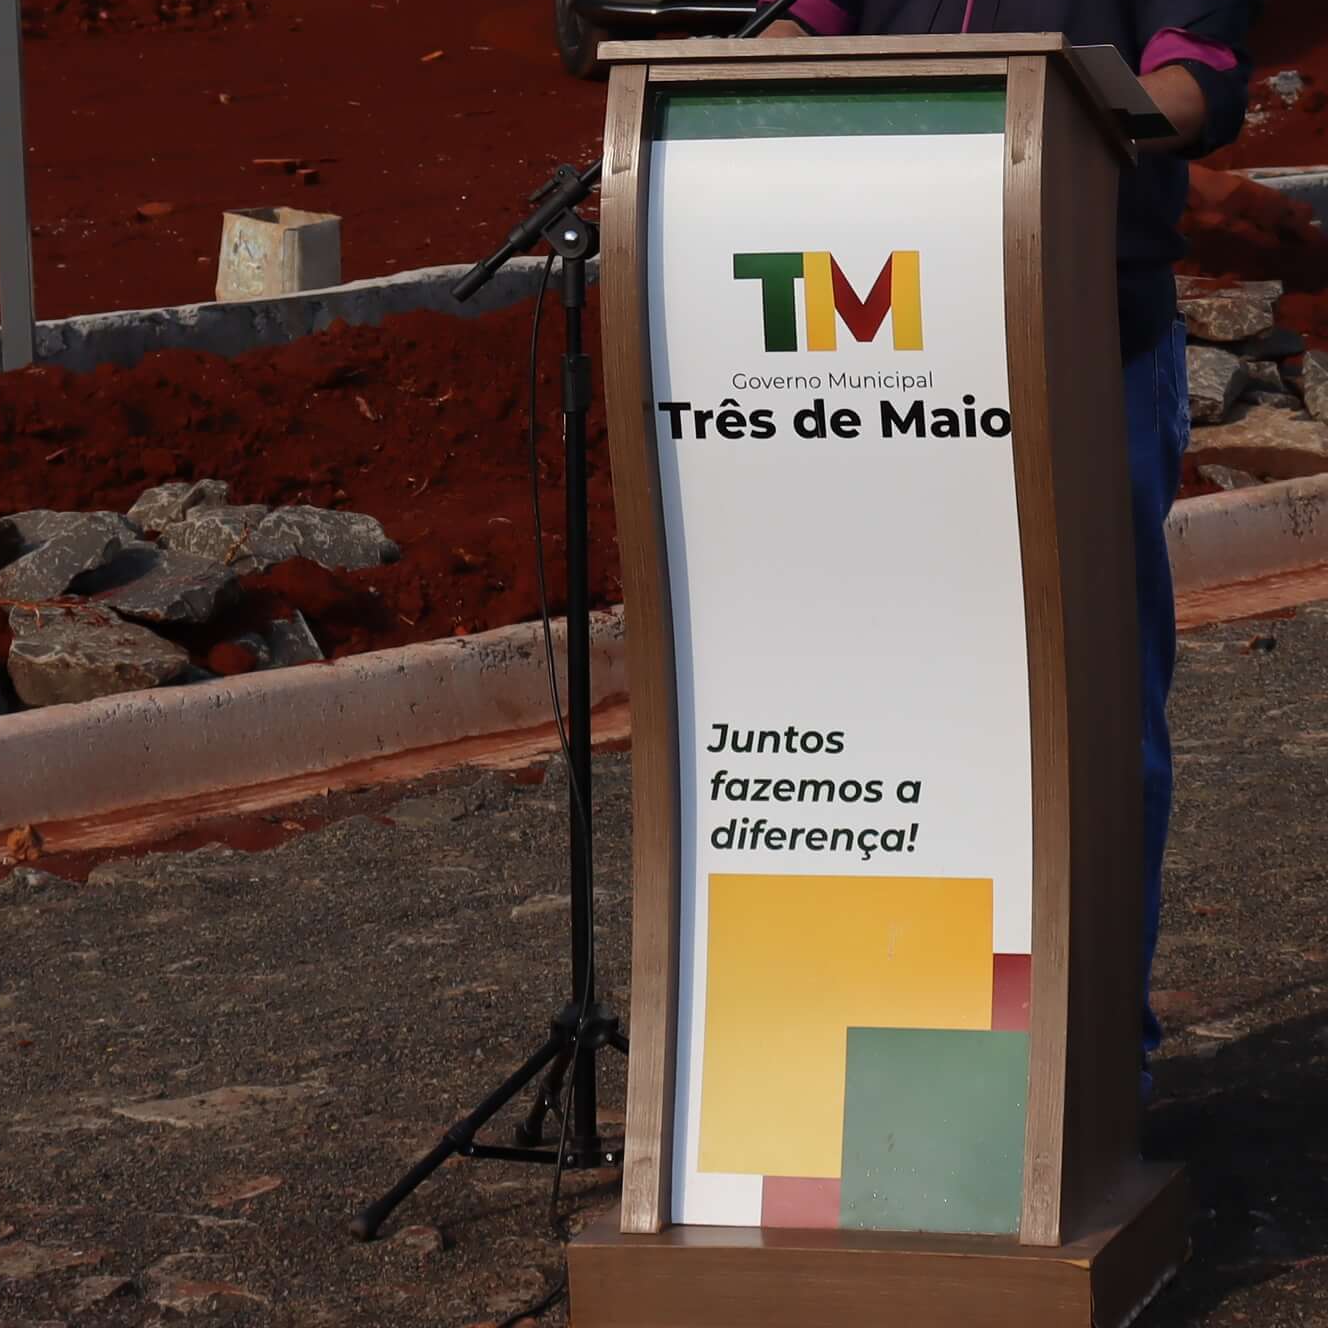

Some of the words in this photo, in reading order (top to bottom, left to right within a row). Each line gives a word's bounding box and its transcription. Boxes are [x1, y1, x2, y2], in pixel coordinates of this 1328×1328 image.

[733, 250, 924, 352] TM
[732, 373, 821, 391] Governo
[829, 370, 933, 393] Municipal
[658, 399, 777, 440] Três
[794, 399, 862, 439] de
[881, 394, 1011, 438] Maio
[706, 724, 845, 754] Juntos
[710, 770, 883, 803] fazemos
[896, 779, 921, 803] a
[710, 817, 919, 861] diferença!
